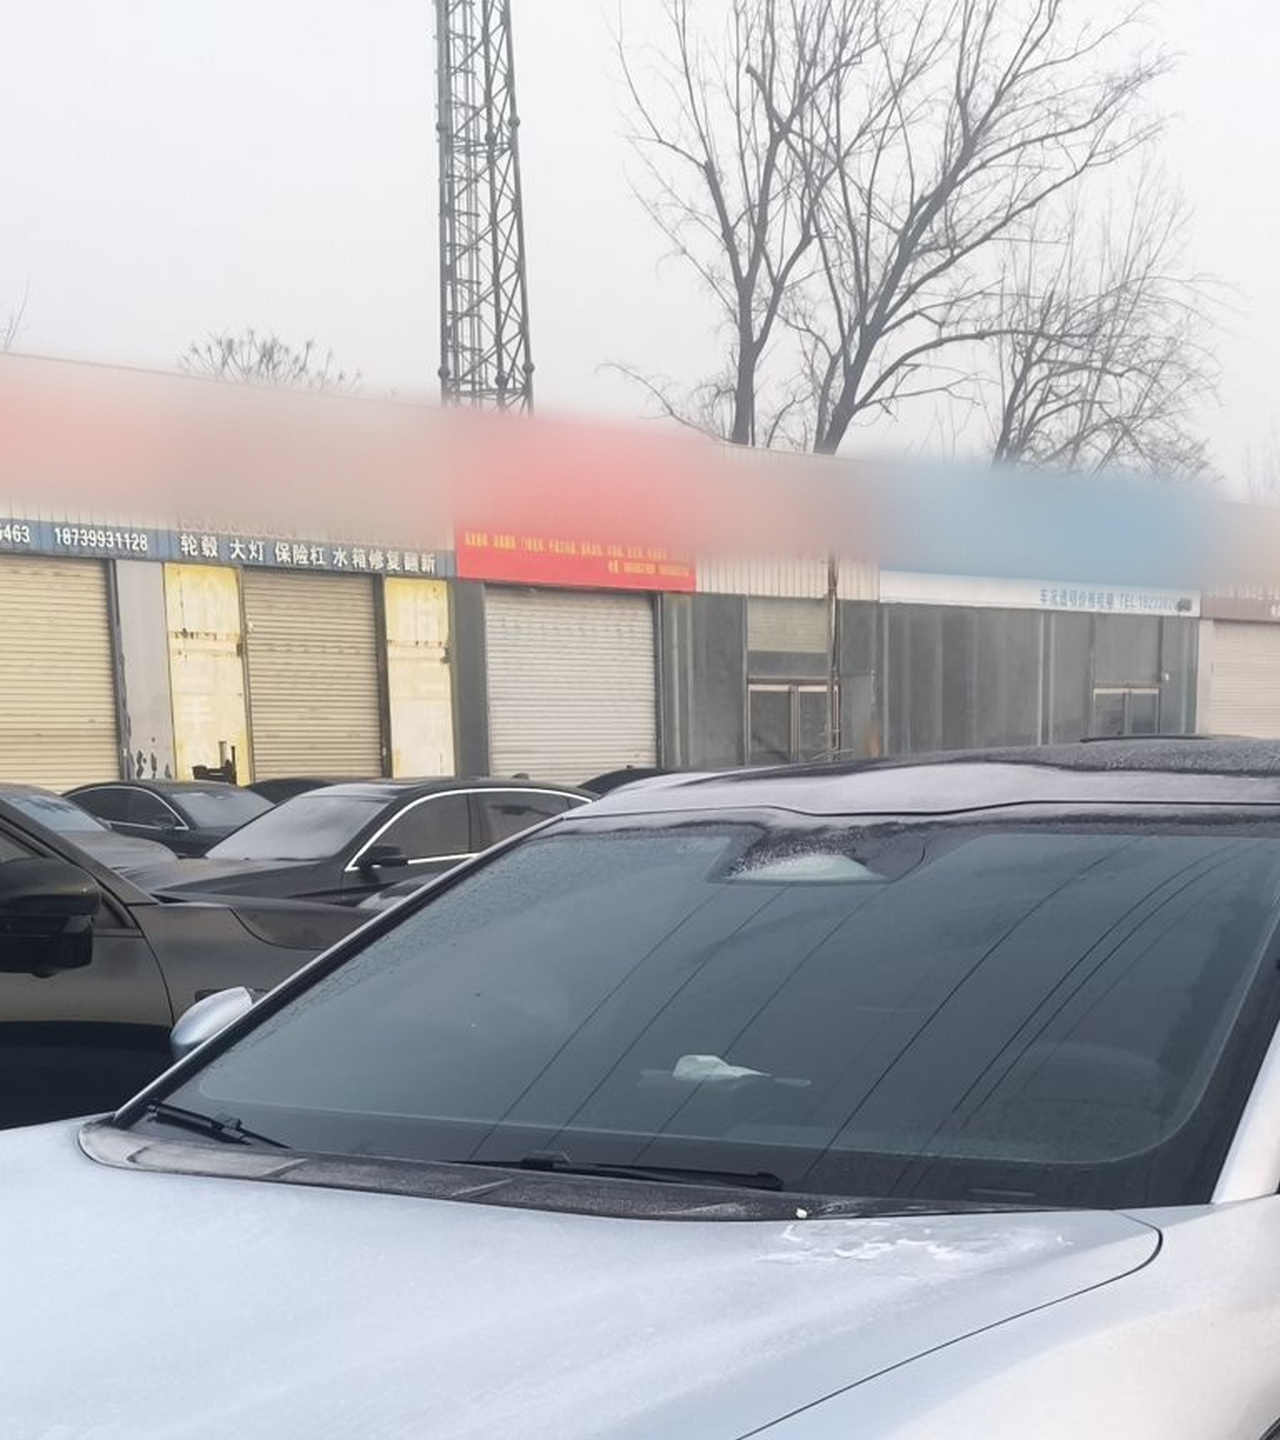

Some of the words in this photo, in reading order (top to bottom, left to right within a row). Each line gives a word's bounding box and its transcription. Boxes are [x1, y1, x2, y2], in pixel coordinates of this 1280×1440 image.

[54, 527, 148, 551] 18739931128
[180, 533, 218, 558] 轮毂
[229, 539, 265, 561] 大灯
[274, 541, 326, 567] 保险杠
